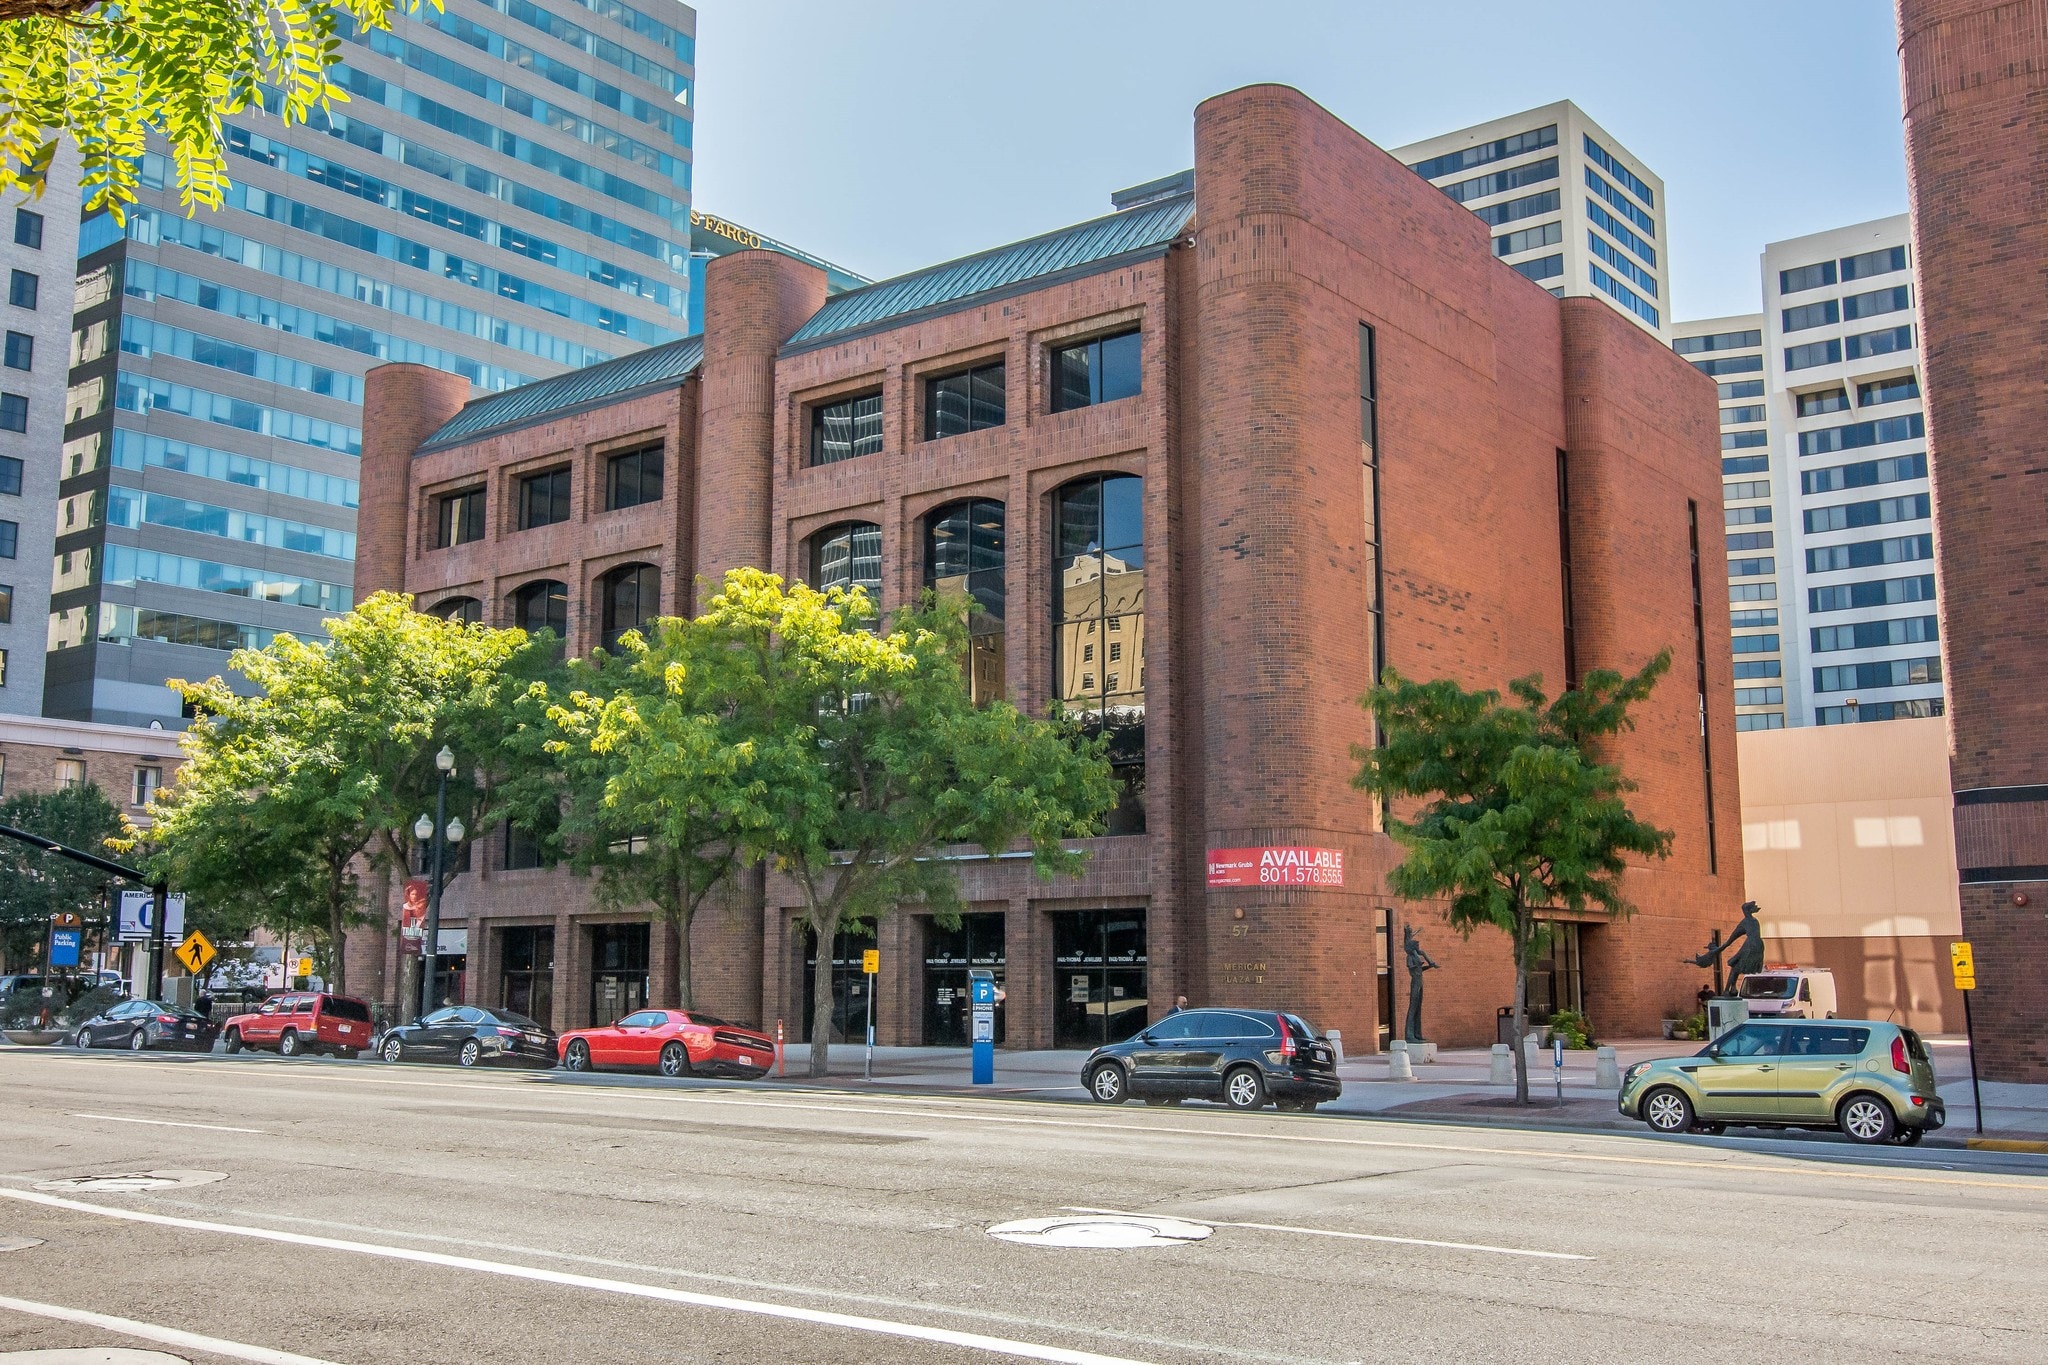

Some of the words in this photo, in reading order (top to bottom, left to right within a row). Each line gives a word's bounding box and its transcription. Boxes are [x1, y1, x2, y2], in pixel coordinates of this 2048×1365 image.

[704, 215, 761, 249] FARGO
[1260, 850, 1342, 868] AVAILABLE
[1260, 867, 1343, 884] 801.578.5555
[66, 914, 74, 924] P
[1233, 925, 1249, 937] 57
[54, 939, 76, 947] Parking
[980, 989, 988, 1000] P
